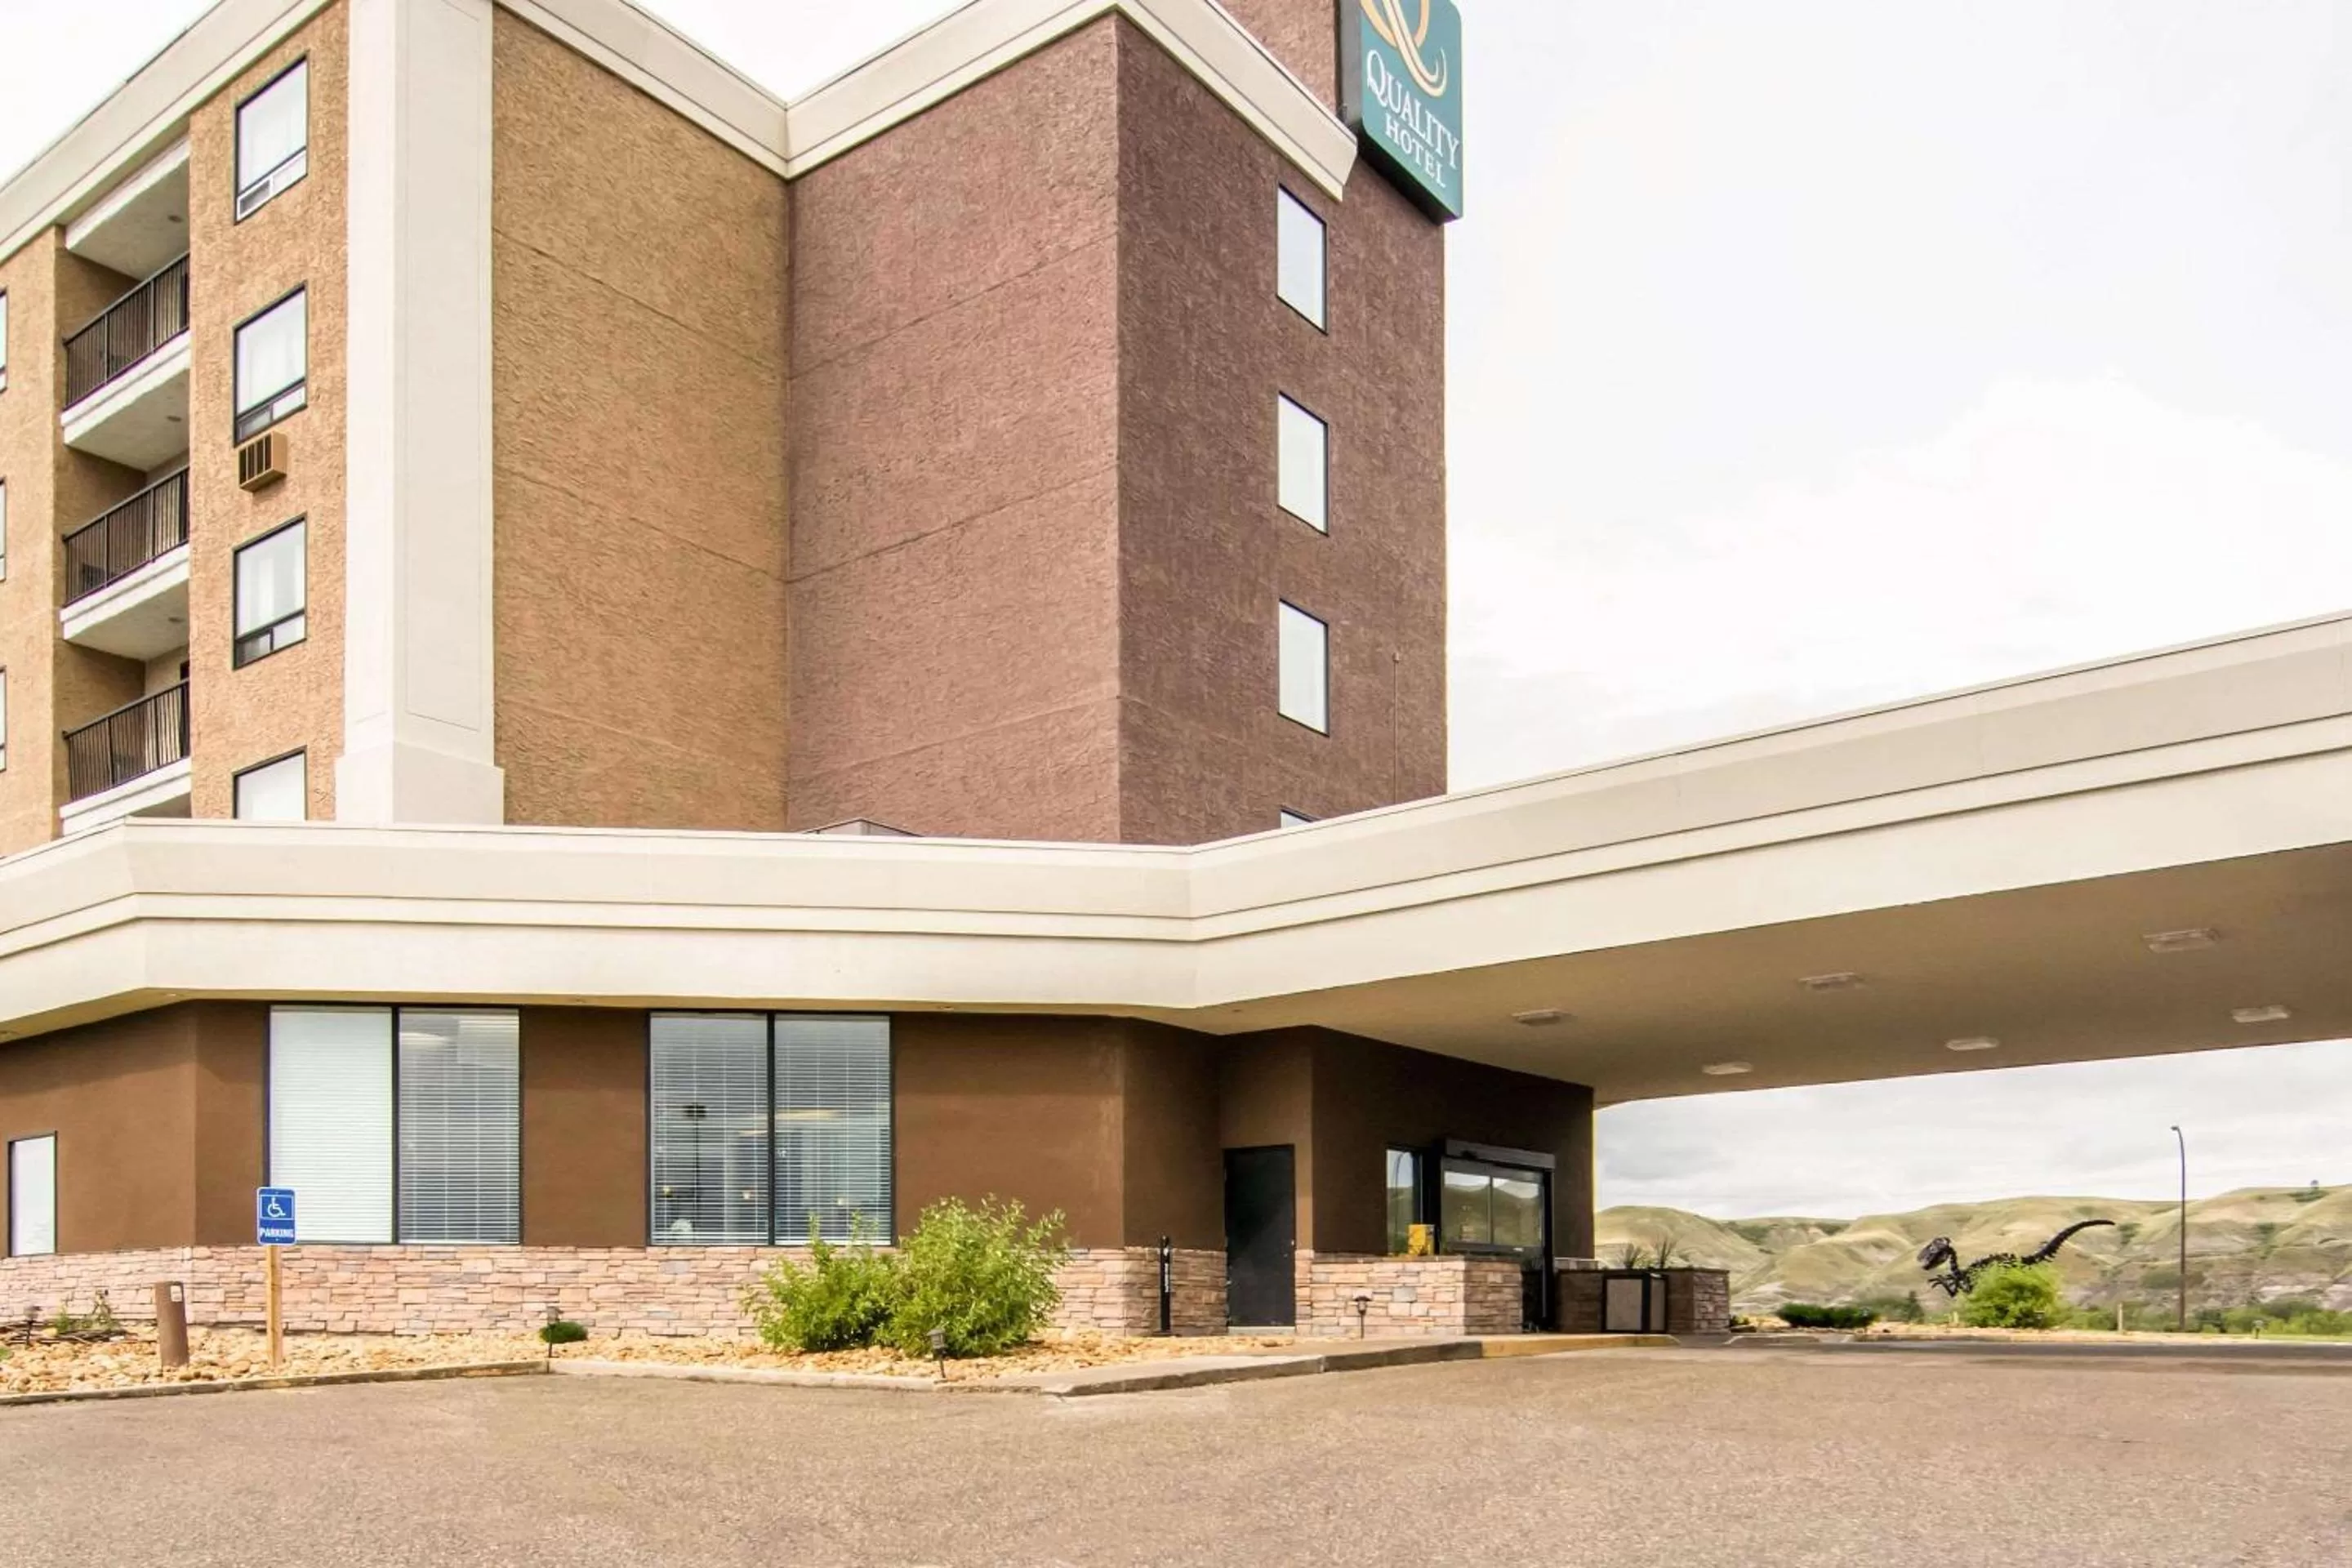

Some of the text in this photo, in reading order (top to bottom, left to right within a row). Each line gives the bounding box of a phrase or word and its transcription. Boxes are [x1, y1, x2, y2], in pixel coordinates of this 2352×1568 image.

[1366, 49, 1459, 170] QUALITY
[1385, 113, 1446, 188] HOTEL
[260, 1227, 294, 1238] PARKING
